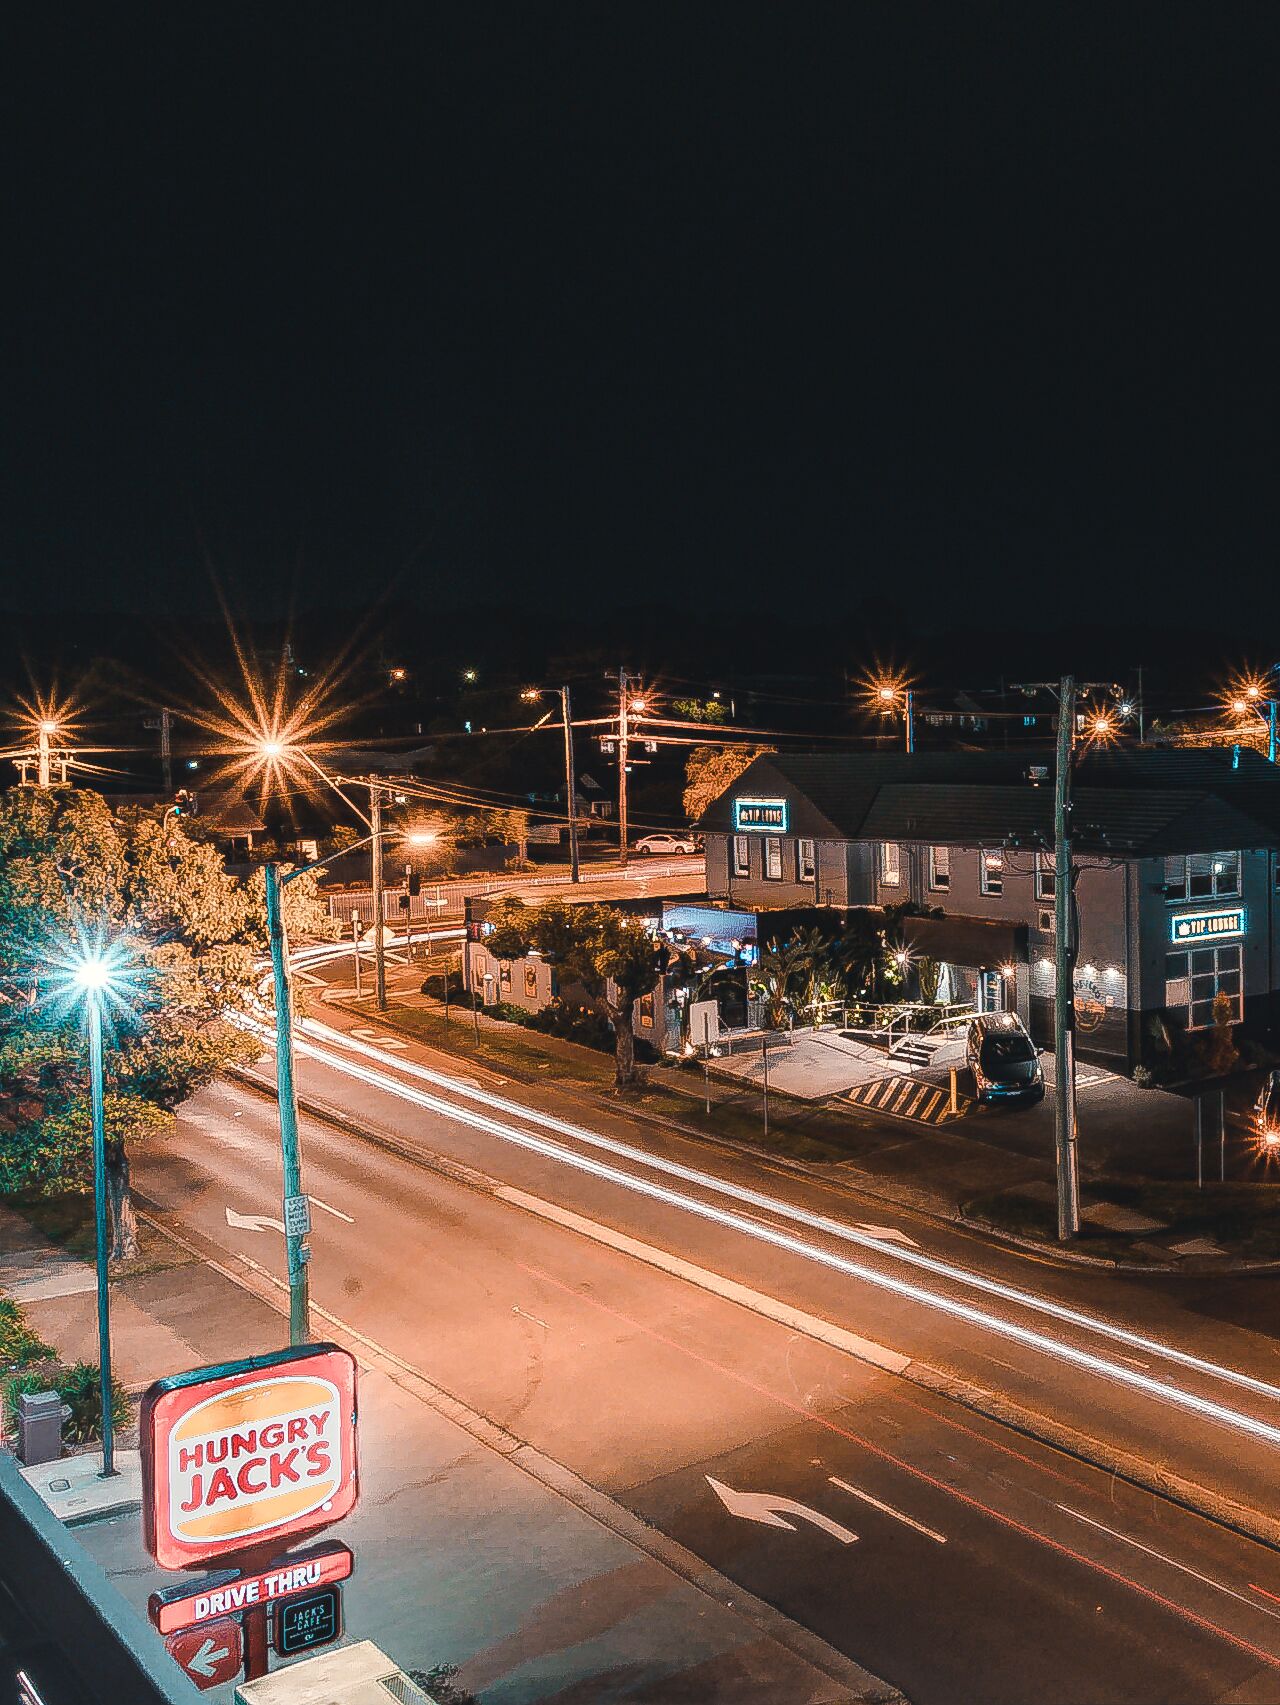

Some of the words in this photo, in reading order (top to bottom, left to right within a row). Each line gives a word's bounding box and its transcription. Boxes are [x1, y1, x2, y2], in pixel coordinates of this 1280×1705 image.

[1190, 919, 1206, 934] VIP
[179, 1410, 331, 1472] HUNGRY
[180, 1440, 332, 1512] JACK'S
[194, 1583, 260, 1620] DRIVE
[264, 1562, 322, 1596] THRU
